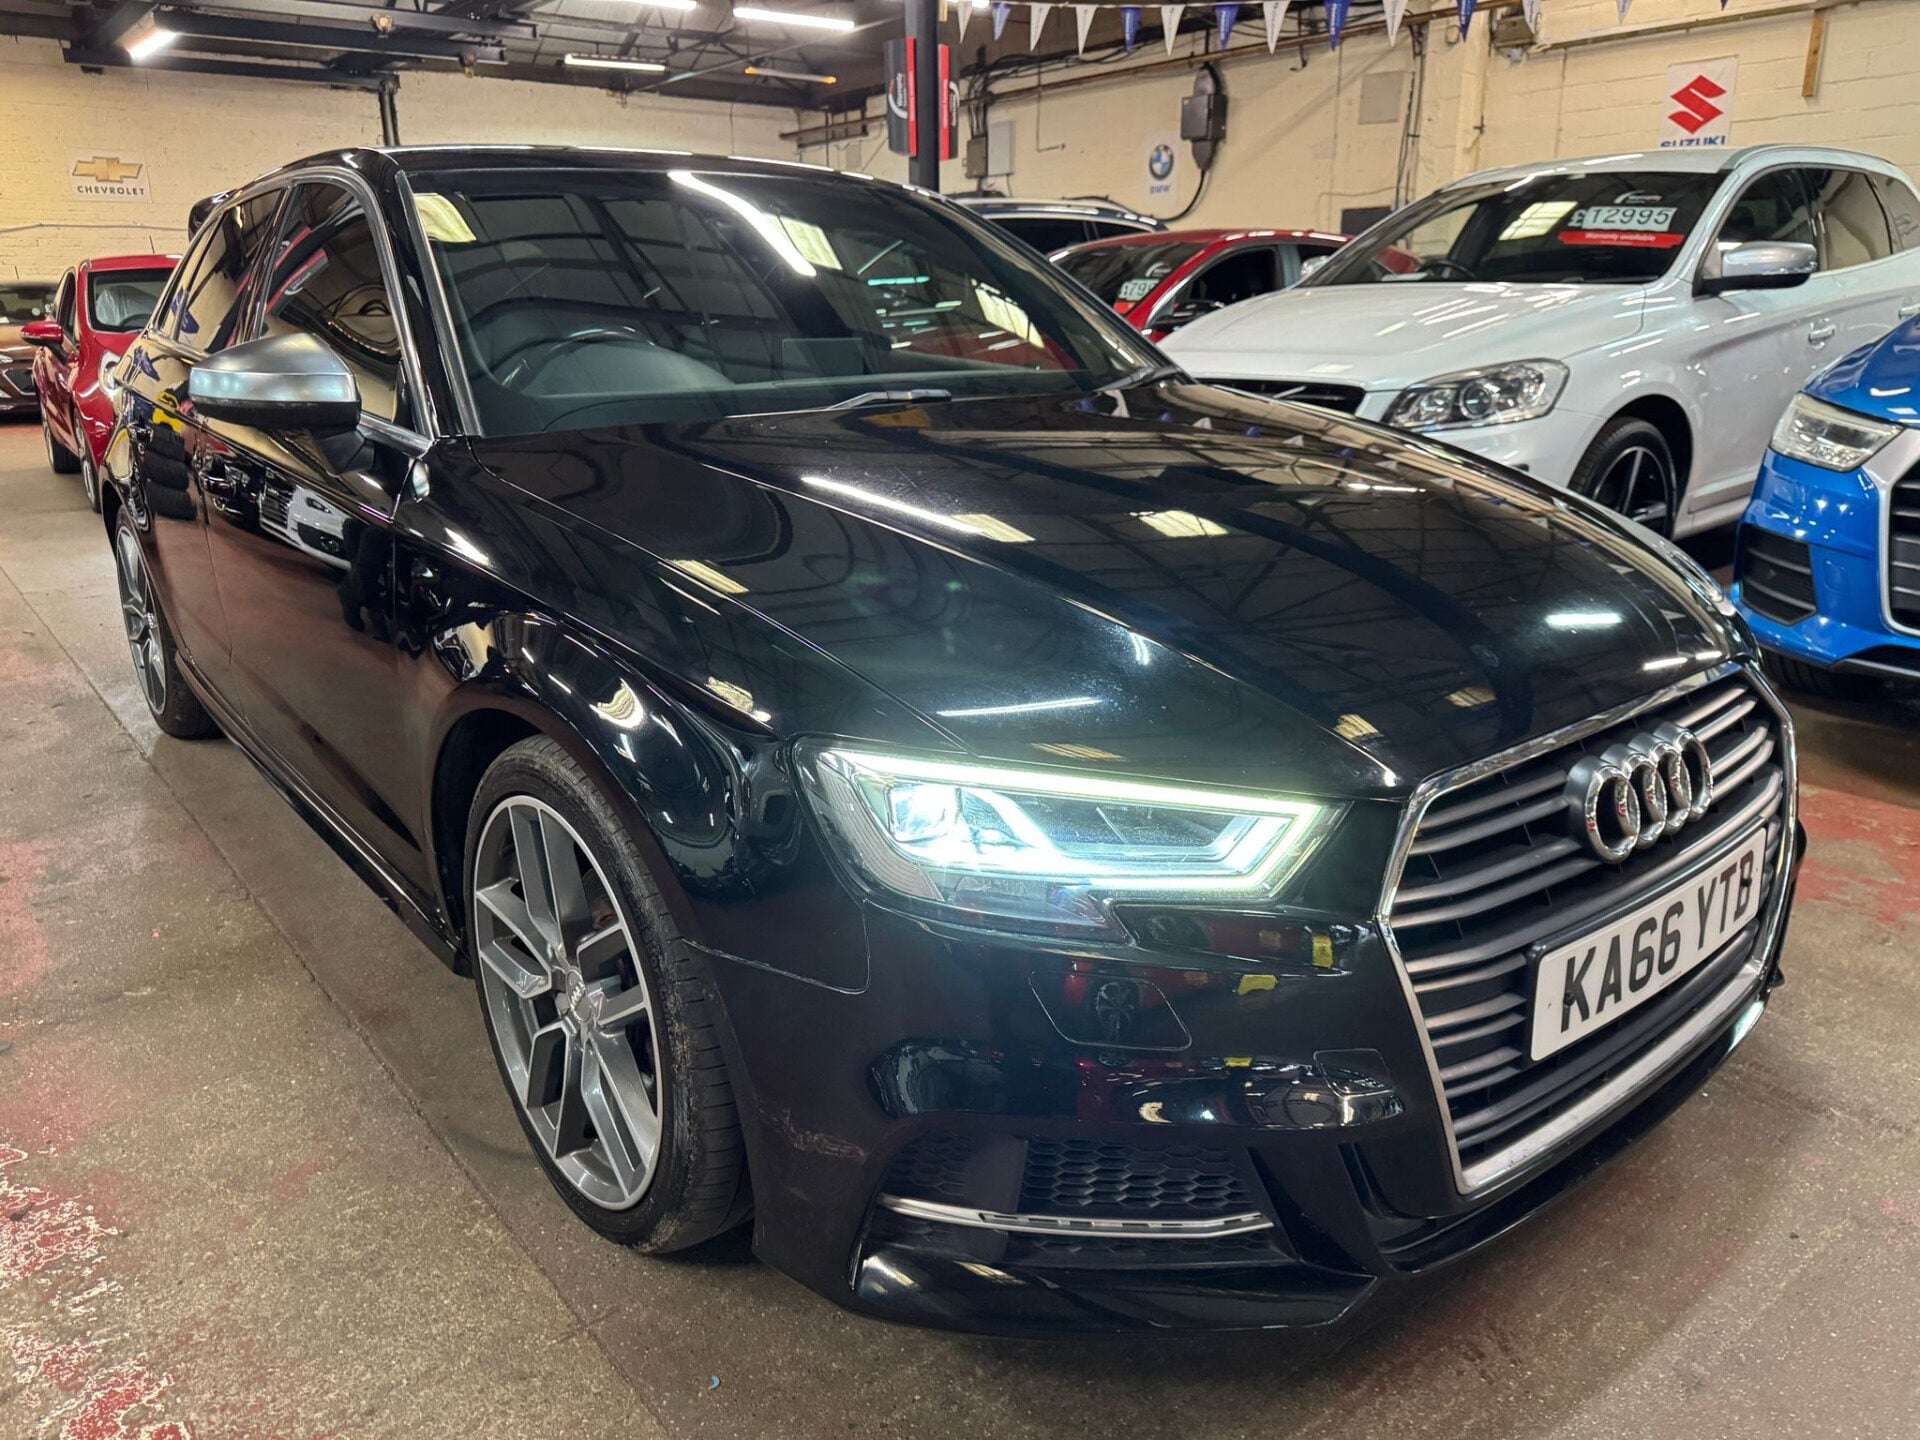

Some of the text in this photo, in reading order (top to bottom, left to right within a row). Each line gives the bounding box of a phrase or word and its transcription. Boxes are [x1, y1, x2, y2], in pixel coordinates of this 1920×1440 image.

[77, 185, 145, 196] CHEVROLET
[1560, 849, 1754, 1033] KA66 YTB
